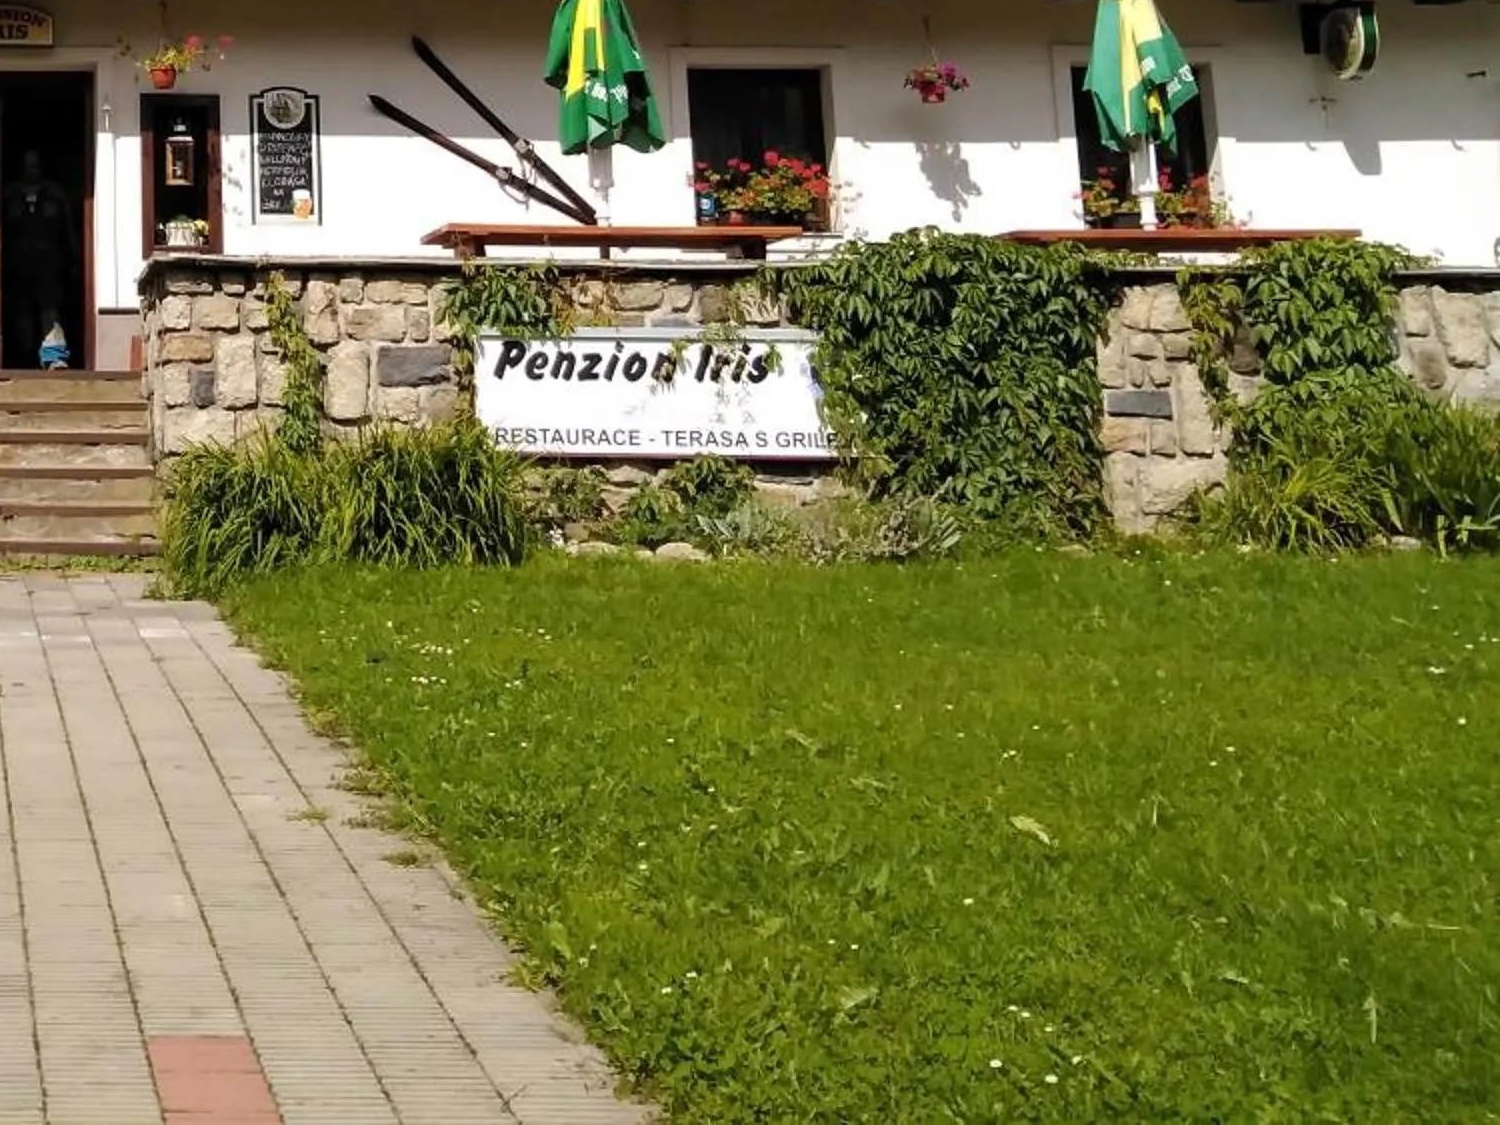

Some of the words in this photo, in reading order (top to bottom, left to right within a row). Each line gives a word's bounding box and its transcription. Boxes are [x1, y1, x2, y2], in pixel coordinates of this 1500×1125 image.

[493, 339, 679, 384] Penzion
[694, 343, 771, 385] Iris
[496, 428, 642, 448] RESTAURACE
[663, 430, 748, 449] TERASA
[755, 431, 769, 449] S
